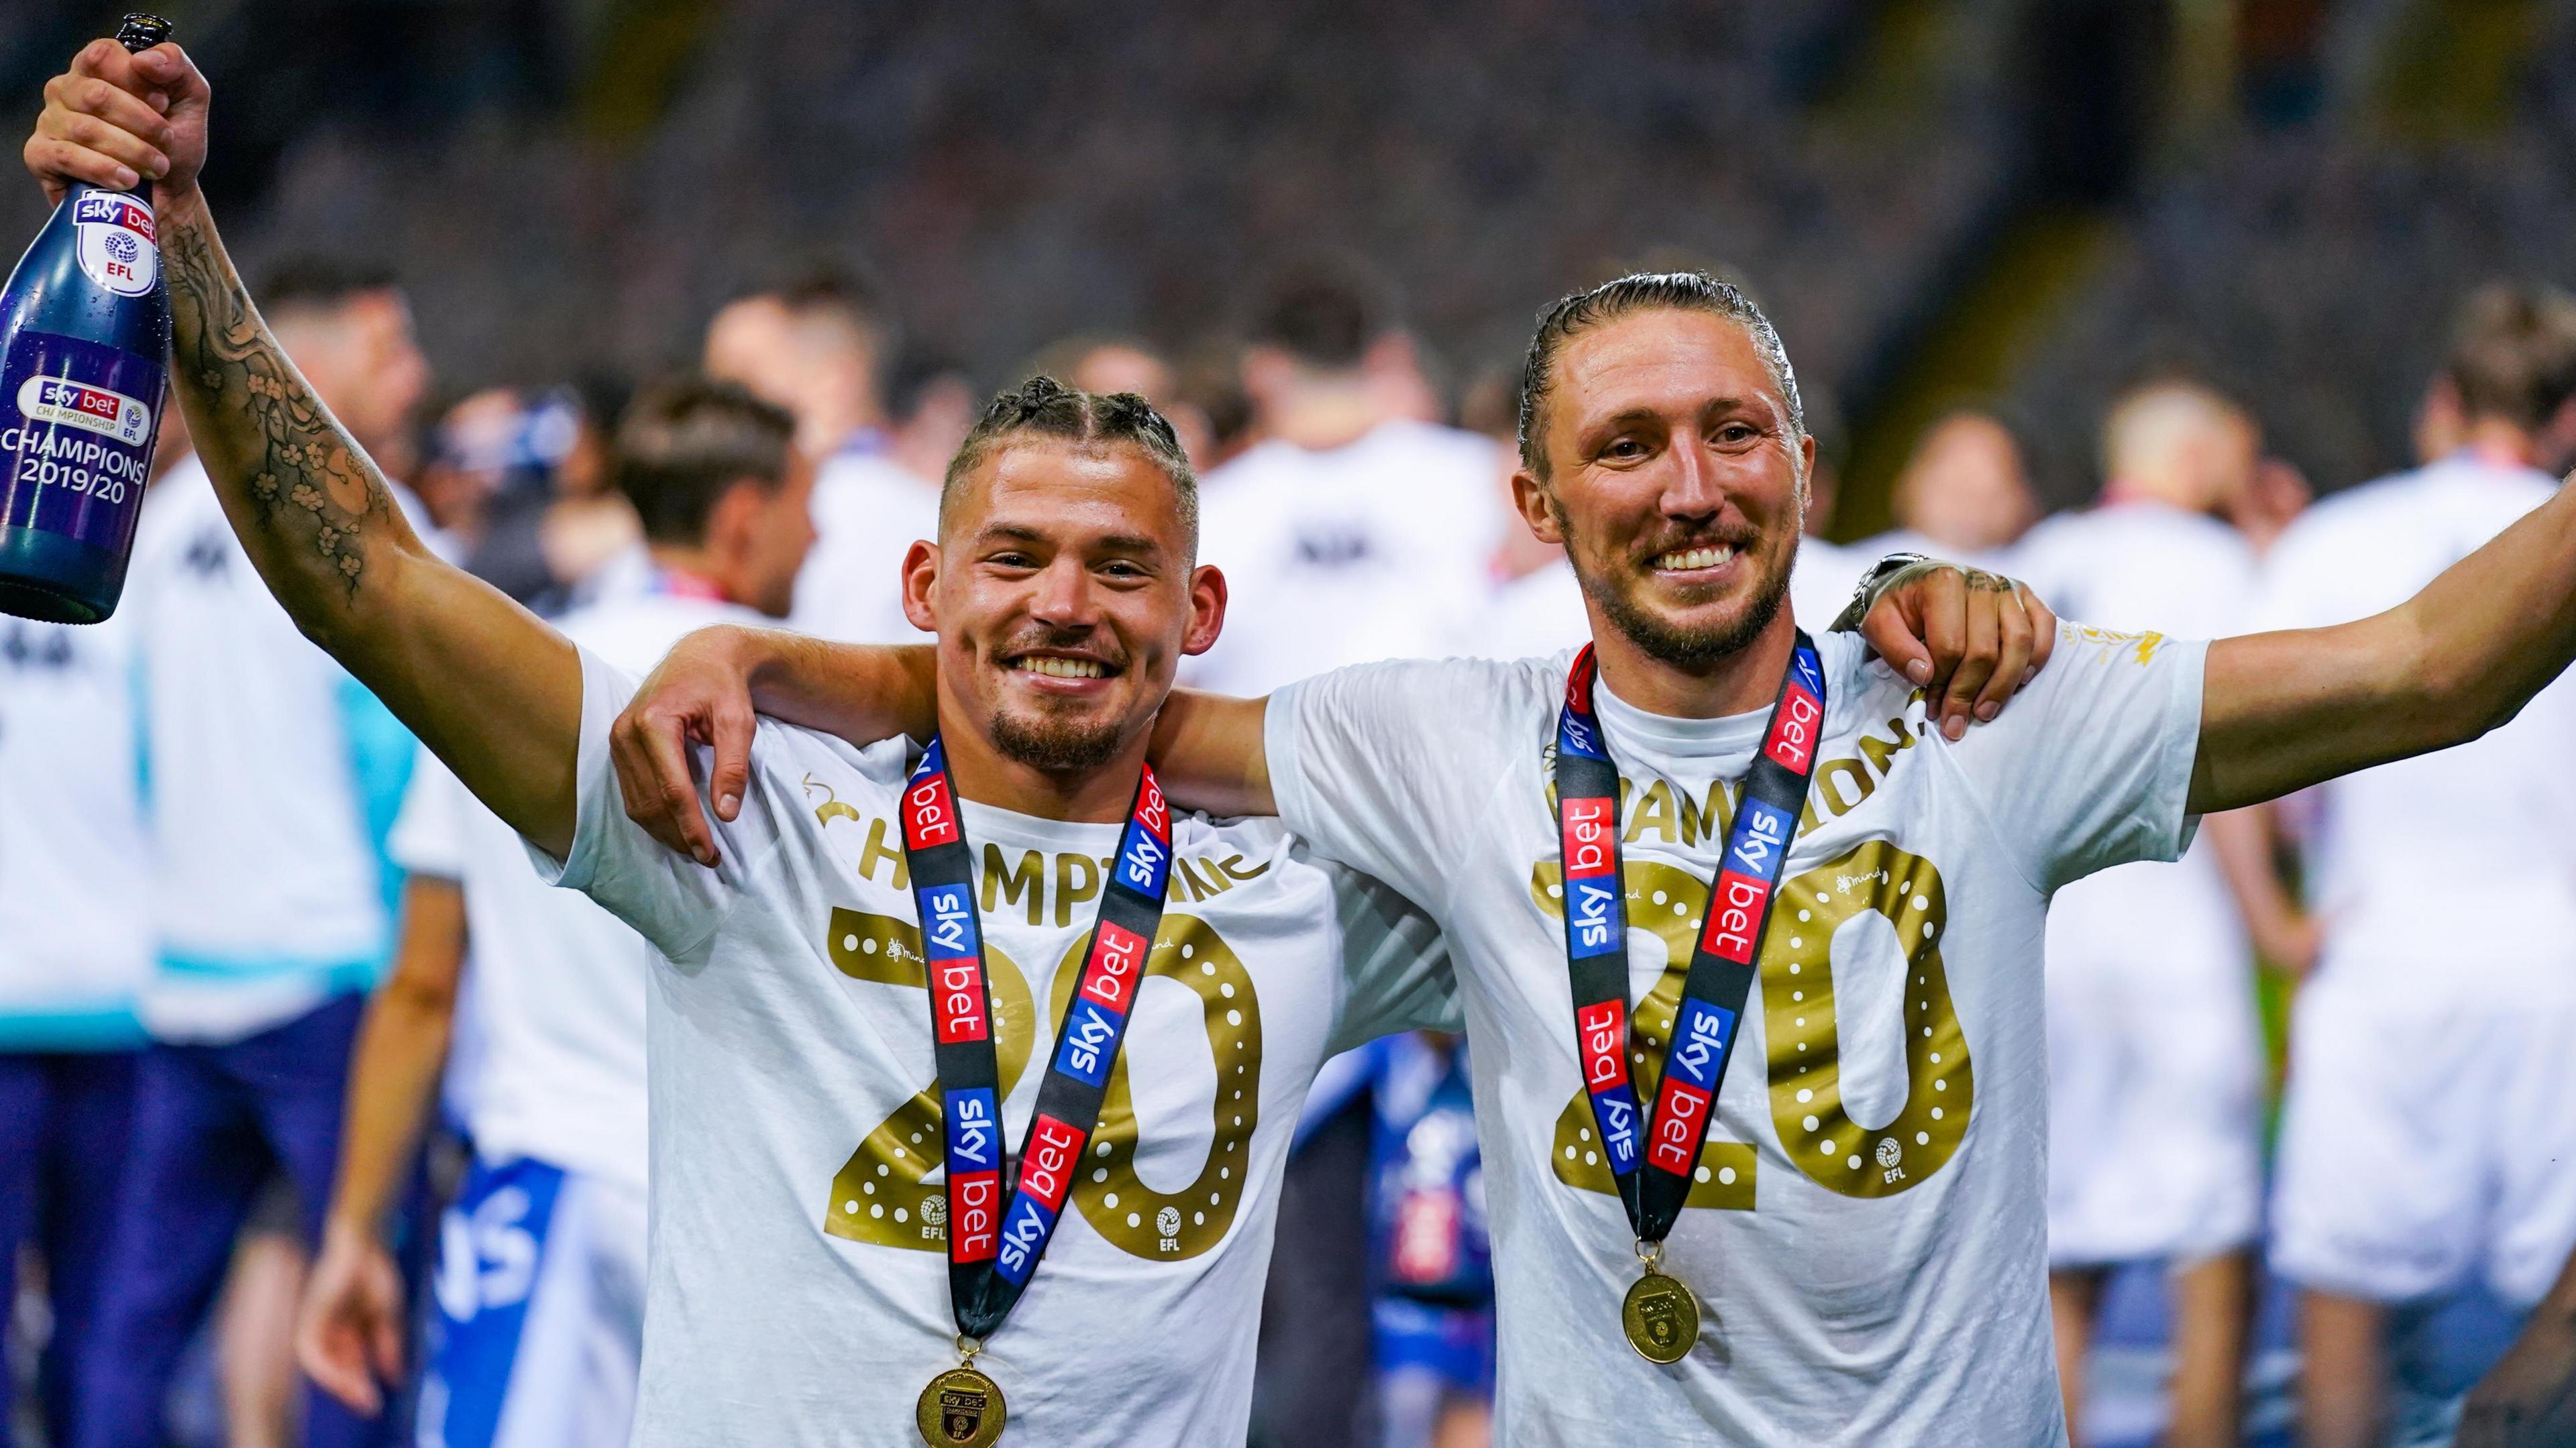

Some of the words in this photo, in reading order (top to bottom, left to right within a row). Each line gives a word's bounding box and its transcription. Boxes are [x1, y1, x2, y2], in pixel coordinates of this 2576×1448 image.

[81, 201, 121, 223] sky
[127, 208, 155, 239] bet
[107, 262, 133, 281] EFL
[44, 387, 79, 406] sky
[83, 392, 116, 414] bet
[1, 428, 145, 485] CHAMPIONS
[123, 428, 137, 441] EFL
[20, 459, 125, 504] 2019/20
[1777, 695, 1819, 763] bet
[912, 780, 950, 841] bet
[1138, 773, 1165, 833] bet
[1126, 830, 1165, 888] sky
[1569, 805, 1602, 871] bet
[1733, 810, 1781, 874] sky
[1850, 866, 1882, 887] mind
[931, 893, 969, 952] sky
[1574, 884, 1613, 946] sky
[1715, 880, 1765, 952] bet
[1086, 933, 1134, 1002] bet
[943, 966, 979, 1034] bet
[1531, 840, 1974, 1211] 20
[1069, 1007, 1114, 1074] sky
[1586, 1010, 1617, 1085] bet
[1676, 1011, 1723, 1082] sky
[824, 906, 1263, 1262] 20
[954, 1099, 987, 1164] sky
[1602, 1097, 1635, 1162] sky
[1658, 1089, 1705, 1164] bet
[1000, 1201, 1046, 1272] sky
[1024, 1127, 1071, 1199] bet
[1883, 1168, 1907, 1185] EFL
[922, 1226, 946, 1240] EFL
[961, 1180, 995, 1253] bet
[1159, 1237, 1180, 1251] EFL
